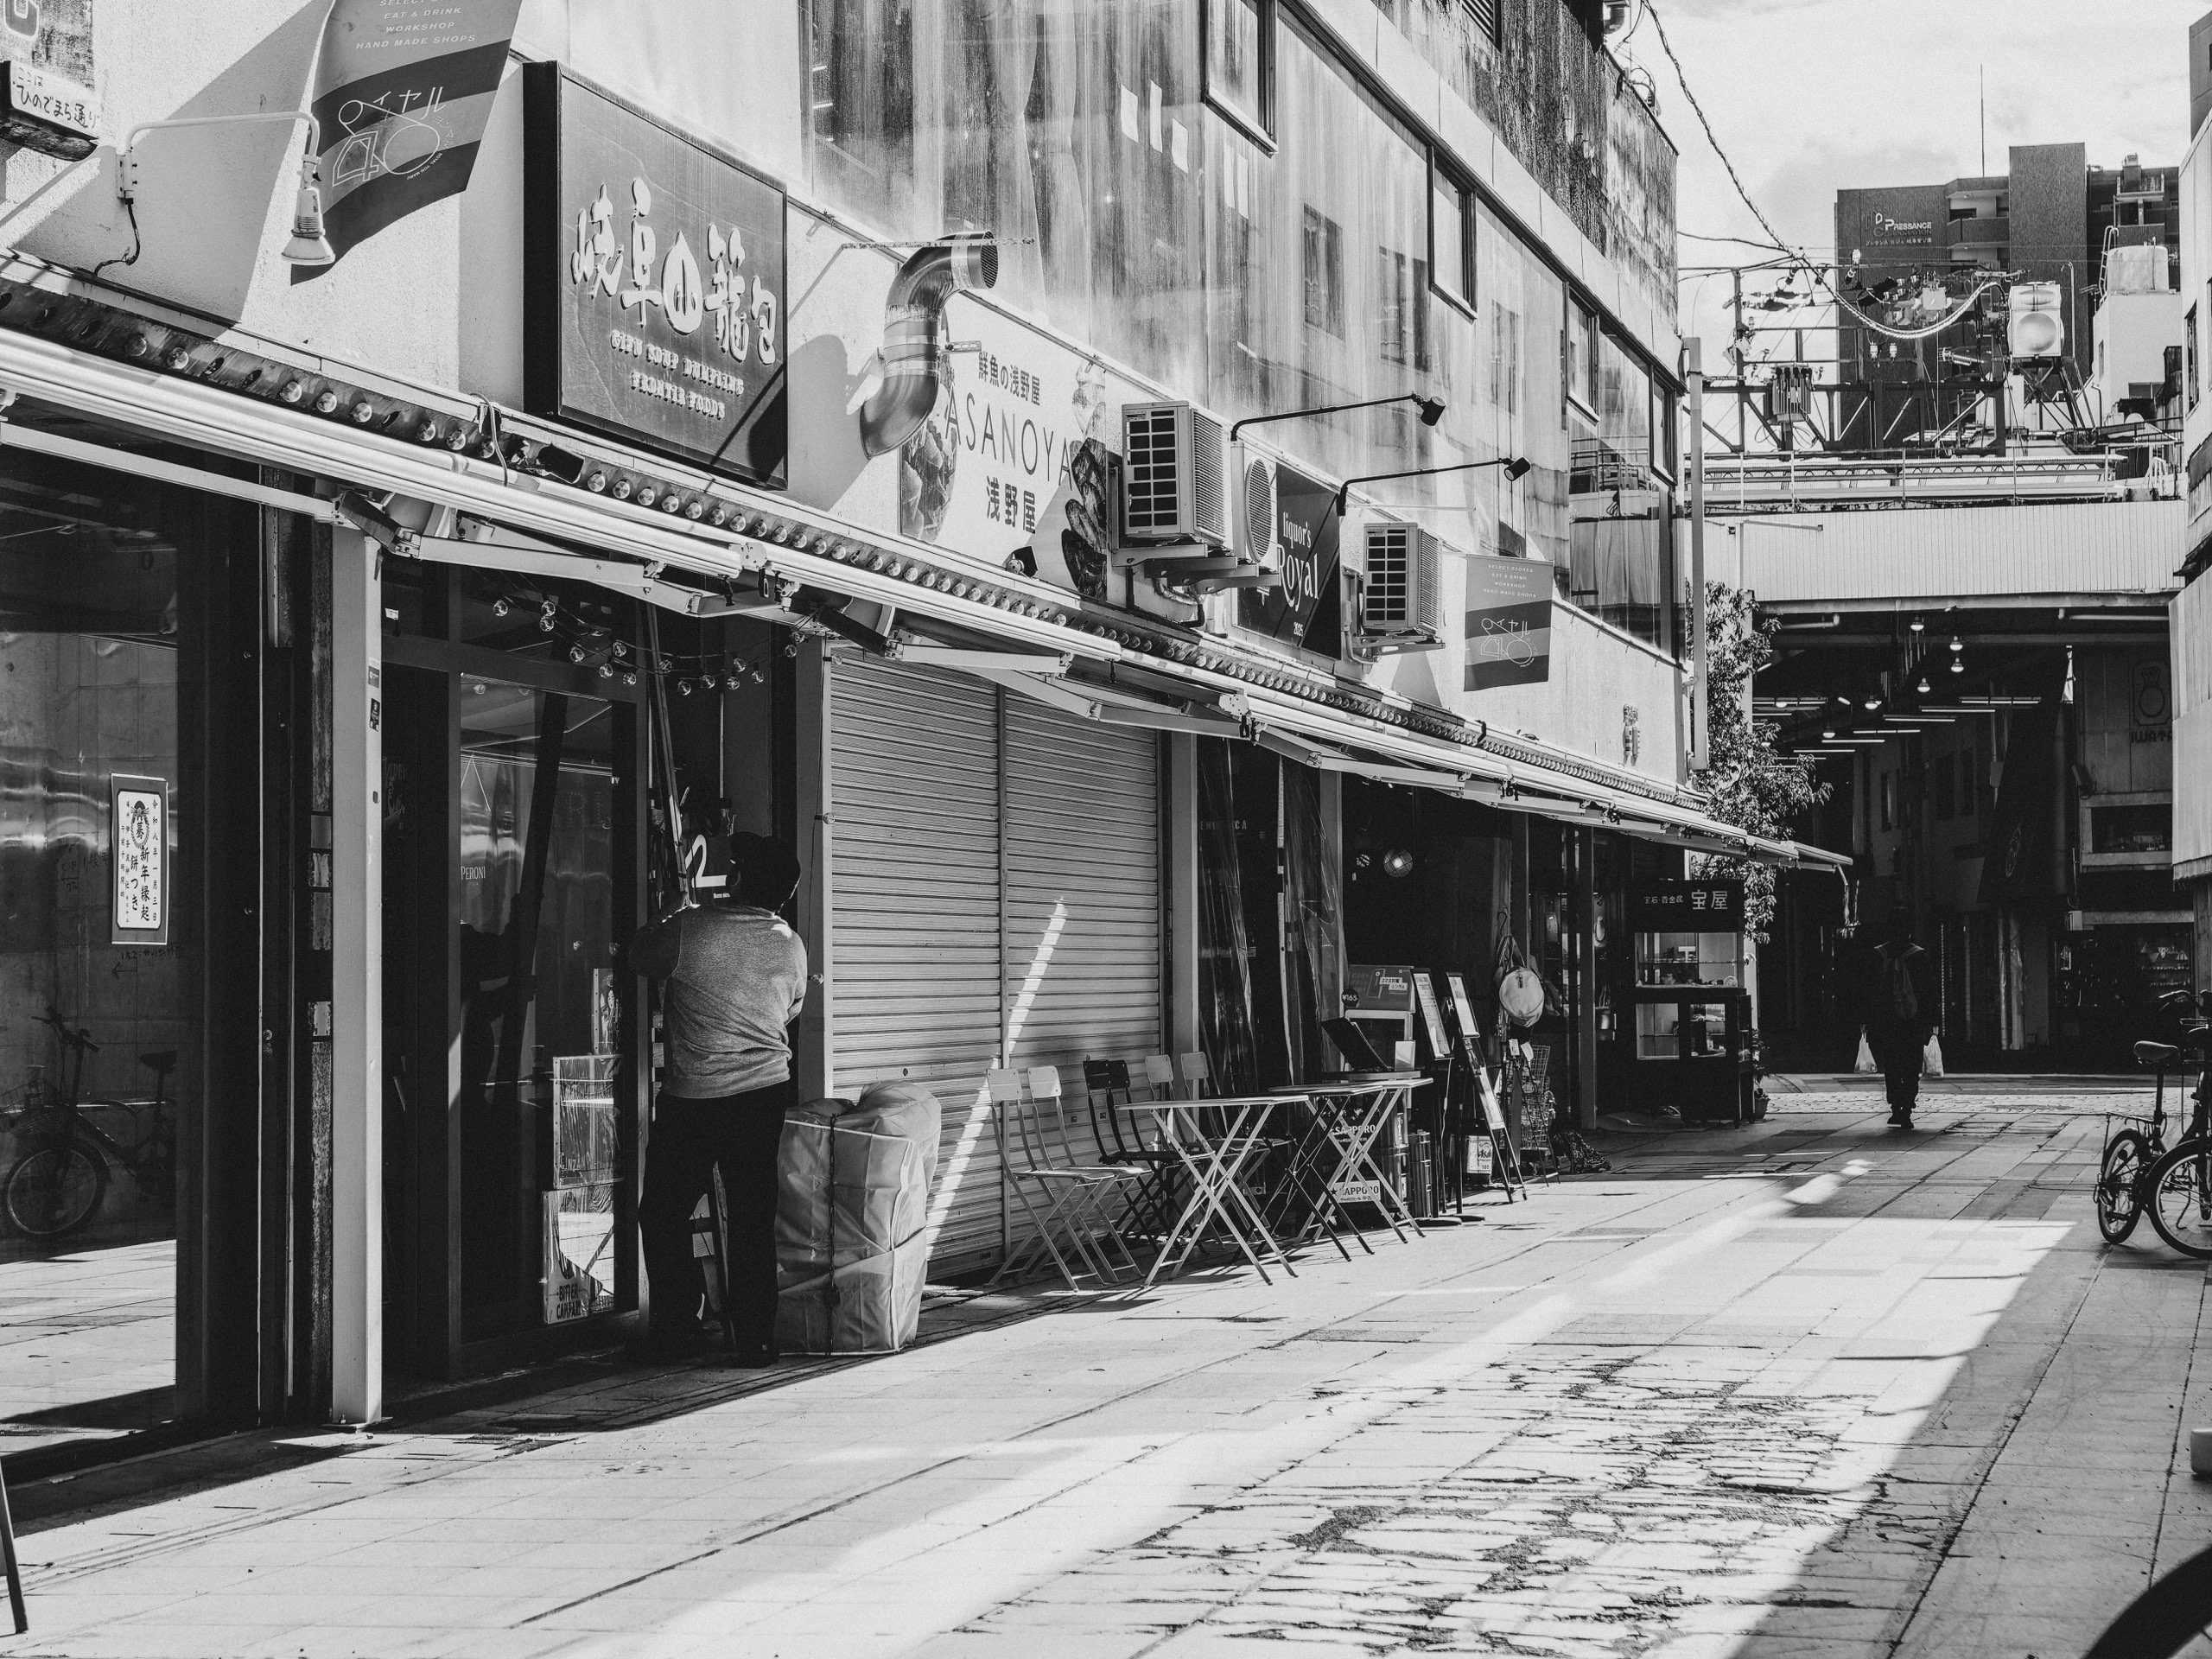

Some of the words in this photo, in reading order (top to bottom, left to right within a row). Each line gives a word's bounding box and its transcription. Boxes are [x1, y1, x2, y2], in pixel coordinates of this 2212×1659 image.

[423, 7, 462, 16] DRINK
[385, 22, 455, 33] WORKSHOP
[355, 41, 389, 49] HAND
[394, 37, 428, 47] MADE
[433, 35, 475, 43] SHOPS
[18, 67, 43, 86] ここは
[1885, 219, 1932, 231] PRESSANCE
[611, 329, 644, 358] GIFU
[646, 343, 679, 372] SOUP
[682, 357, 745, 397] DUMPLING
[978, 350, 1040, 406] 鮮魚の浅野屋
[687, 391, 726, 421] FOODS
[944, 385, 1073, 492] ASANOYA
[986, 475, 1037, 535] 浅野屋
[1282, 511, 1312, 549] liquor's
[1278, 543, 1319, 613] Royal
[1293, 621, 1304, 638] 2025
[130, 854, 139, 912] 餅つき
[140, 844, 150, 922] 新年縁起
[461, 865, 486, 880] PERONI
[1691, 889, 1729, 910] 宝屋
[1342, 994, 1358, 1002] ¥165
[1339, 1185, 1380, 1196] APPOO
